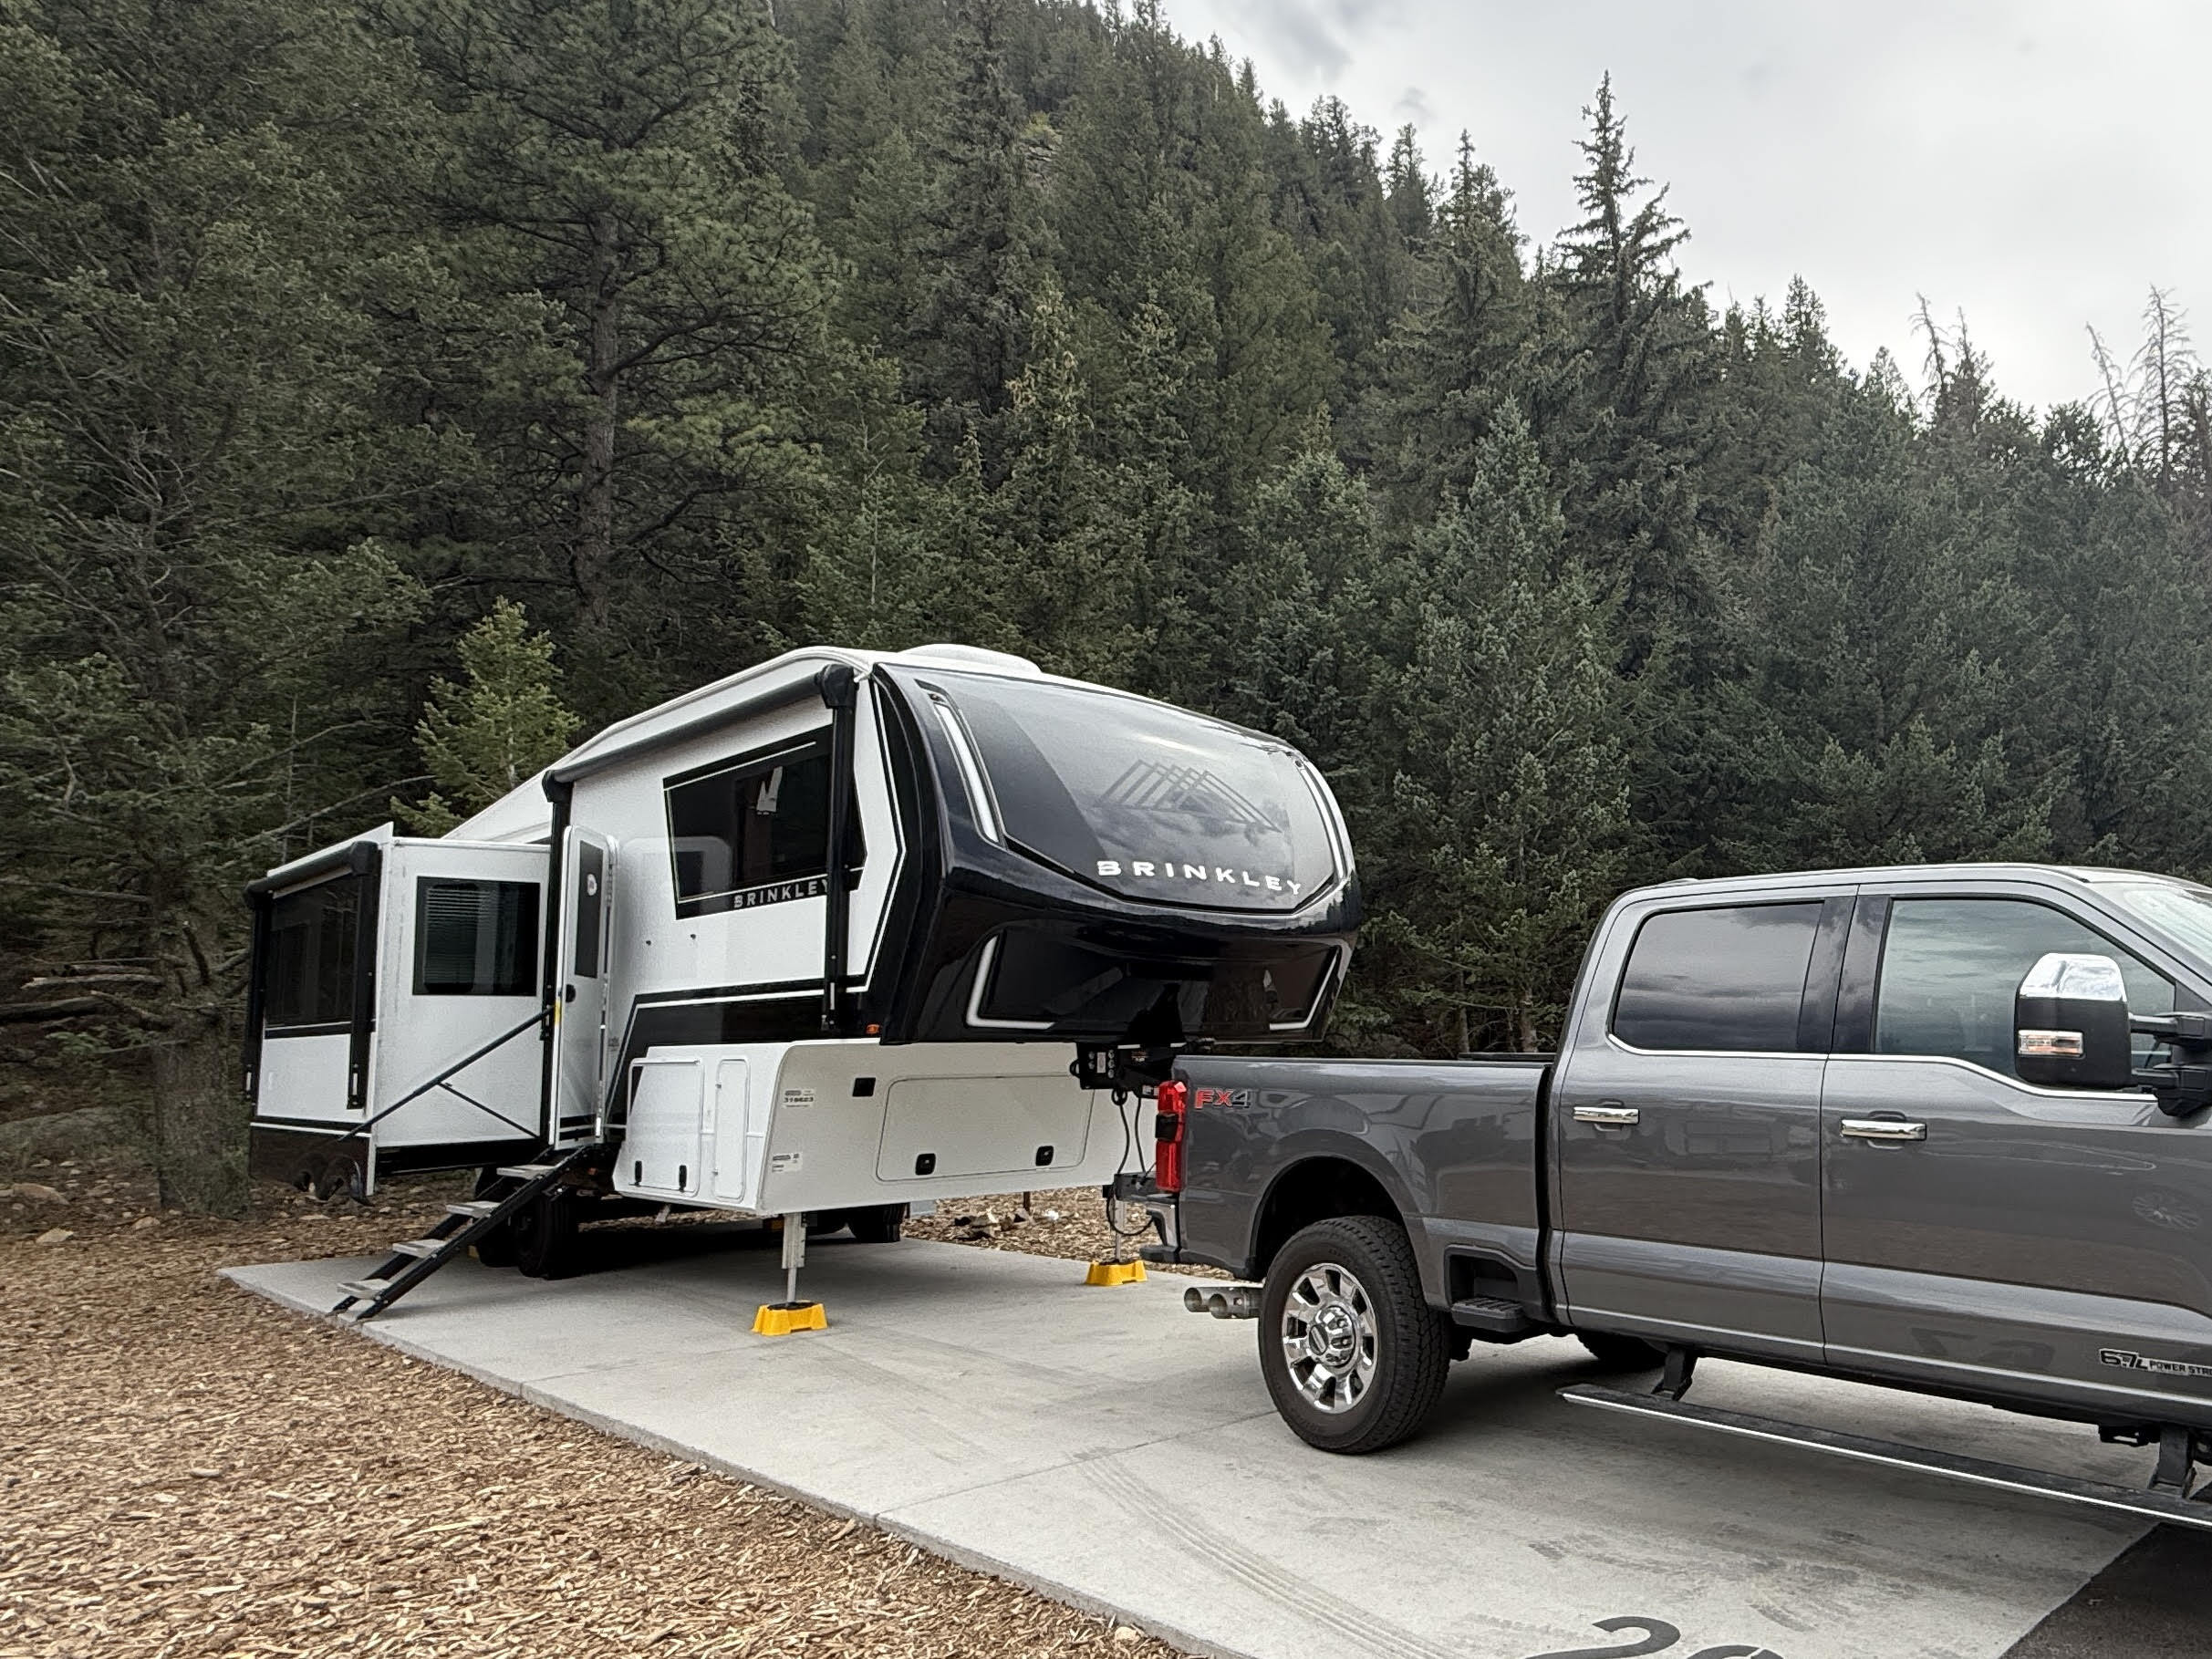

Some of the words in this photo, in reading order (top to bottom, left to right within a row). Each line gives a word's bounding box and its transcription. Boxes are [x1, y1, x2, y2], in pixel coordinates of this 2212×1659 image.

[1096, 860, 1301, 896] BRINKLEY
[1194, 1088, 1251, 1109] FX4
[2149, 1360, 2186, 1374] POWER
